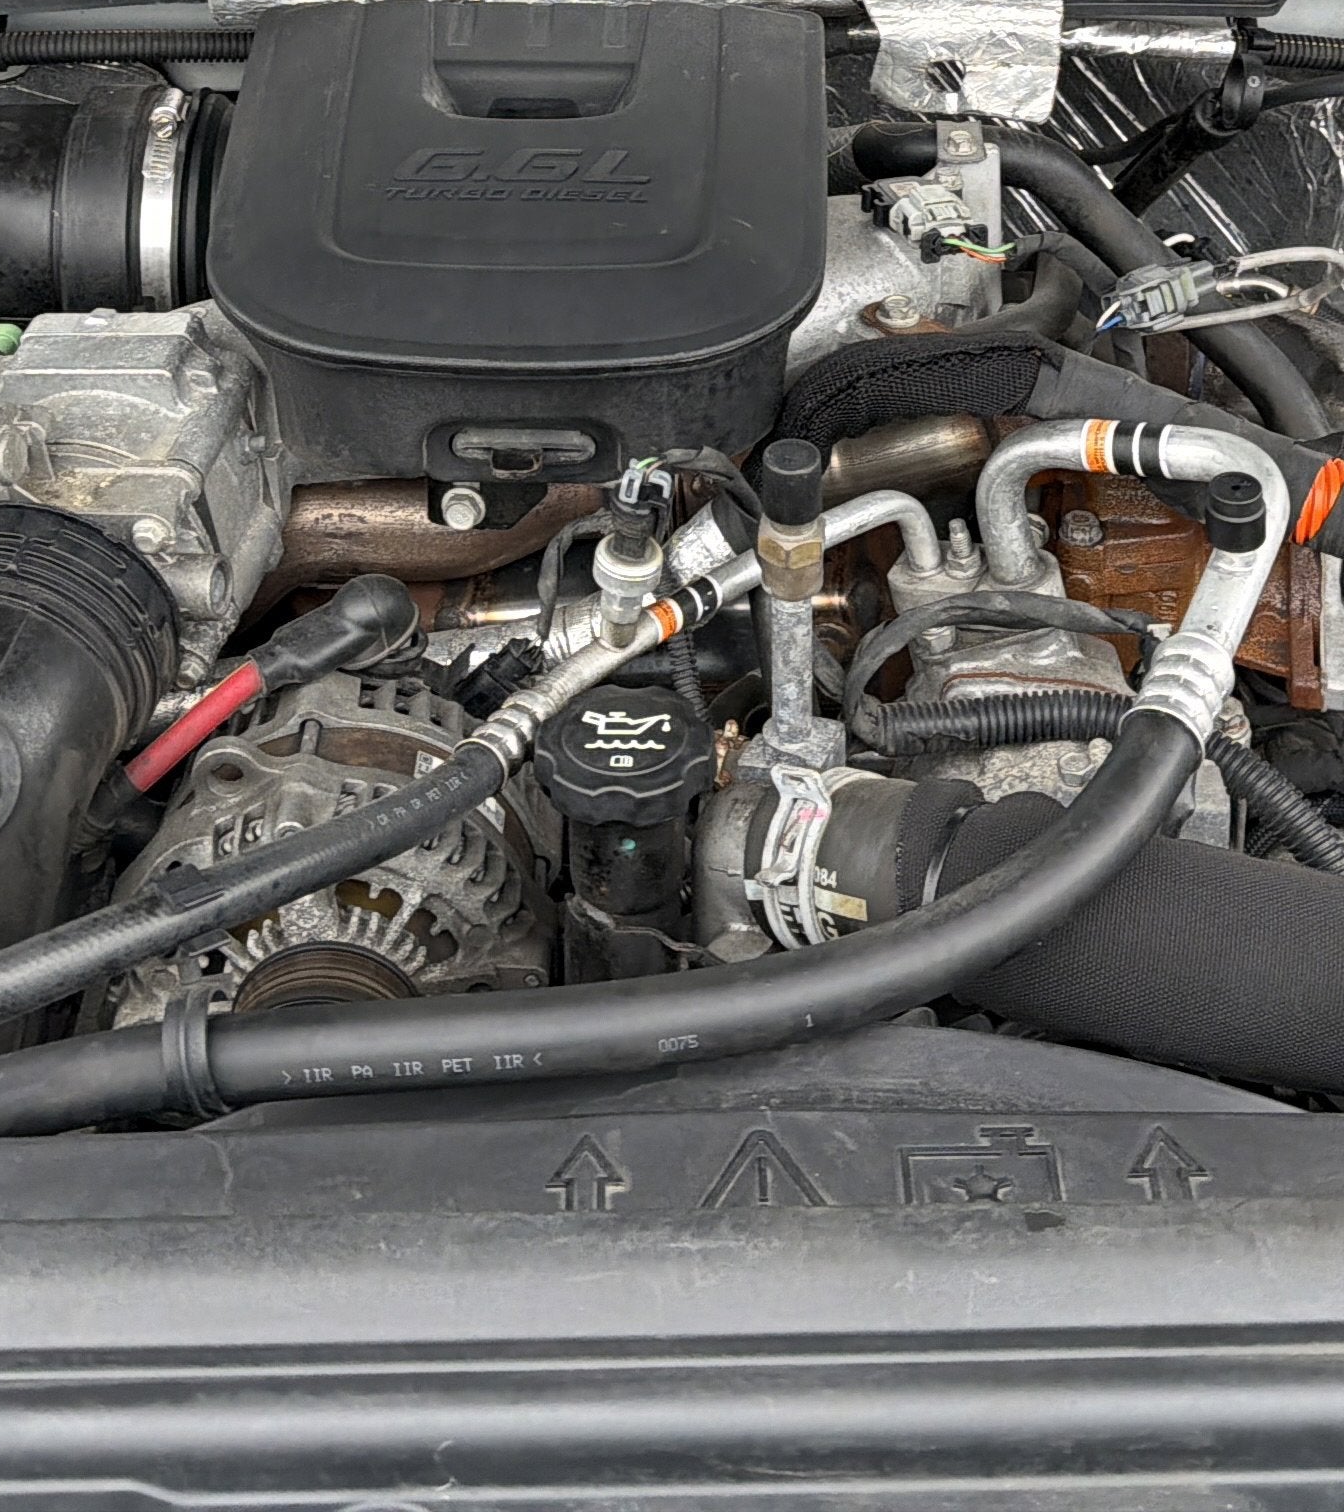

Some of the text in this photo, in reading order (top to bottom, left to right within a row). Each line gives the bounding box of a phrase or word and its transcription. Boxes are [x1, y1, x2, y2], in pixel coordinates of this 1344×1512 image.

[393, 148, 652, 185] 6.6L
[386, 187, 650, 204] TURBO DIESEL
[658, 1034, 699, 1053] 0075
[351, 1064, 374, 1079] PA
[441, 1057, 473, 1074] PET
